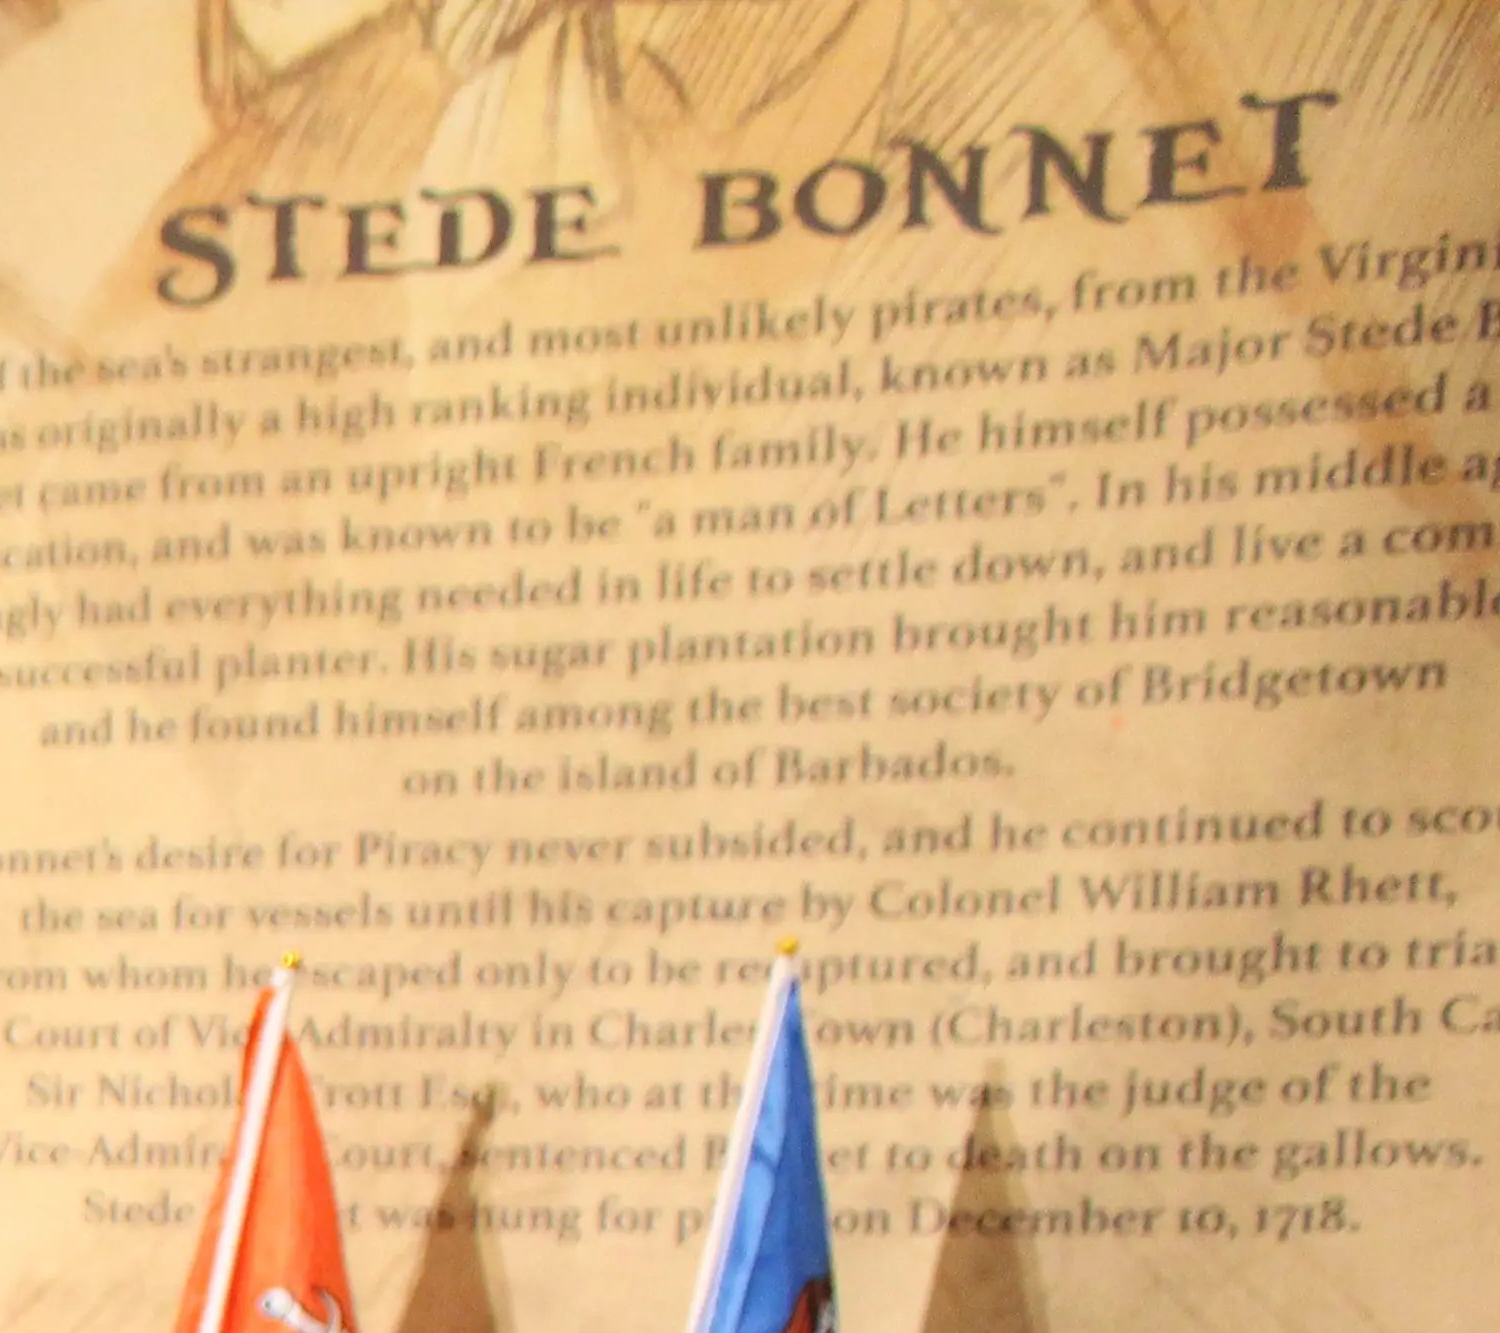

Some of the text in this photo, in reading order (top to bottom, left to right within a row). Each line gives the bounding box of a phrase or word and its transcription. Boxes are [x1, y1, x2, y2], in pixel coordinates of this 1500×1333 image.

[156, 91, 1341, 309] STEDE BONNET
[20, 350, 84, 391] the
[428, 319, 513, 364] and
[528, 319, 639, 358] most
[655, 293, 855, 348] unlikely
[871, 287, 1058, 344] pirates,
[1072, 270, 1197, 312] from
[1215, 250, 1299, 299] the
[35, 400, 245, 455] originally
[259, 409, 282, 437] a
[296, 390, 397, 443] high
[410, 383, 591, 428] ranking
[606, 357, 864, 414] individual,
[879, 355, 1048, 394] known
[1064, 349, 1117, 380] as
[1134, 326, 1292, 375] Major
[1304, 301, 1459, 356] Stede
[37, 478, 147, 516] came
[159, 462, 265, 503] from
[279, 467, 333, 497] an
[347, 447, 517, 504] upright
[533, 434, 696, 483] French
[896, 418, 962, 460] He
[979, 396, 1177, 452] himself
[1185, 369, 1449, 441] possessed
[1464, 378, 1492, 413] a
[151, 521, 231, 564] and
[245, 529, 327, 558] was
[340, 516, 493, 554] known
[508, 516, 553, 545] to
[566, 503, 621, 543] be
[692, 503, 795, 535] man
[808, 487, 864, 529] of
[1097, 471, 1147, 510] In
[1165, 462, 1239, 505] his
[1255, 442, 1447, 496] middle
[75, 586, 152, 628] had
[164, 578, 403, 630] everything
[417, 566, 582, 612] needed
[598, 568, 641, 605] in
[657, 559, 733, 601] life
[747, 567, 795, 597] to
[807, 548, 938, 592] settle
[952, 541, 1105, 585] down,
[1119, 526, 1215, 574] and
[1233, 523, 1324, 565] live
[1338, 529, 1367, 559] a
[214, 641, 388, 695] planter.
[403, 636, 477, 675] His
[489, 640, 612, 681] sugar
[628, 619, 875, 678] plantation
[893, 603, 1091, 658] brought
[1110, 599, 1207, 641] him
[39, 657, 1448, 748] and he found himself among the best society of Bridgetown
[401, 739, 1015, 797] on the island of Barbados.
[134, 835, 264, 872] desire
[277, 831, 340, 870] for
[355, 831, 493, 876] Piracy
[505, 836, 632, 865] never
[646, 815, 868, 862] subsided,
[882, 813, 973, 856] and
[990, 812, 1048, 853] he
[1061, 798, 1325, 848] continued
[1342, 807, 1393, 839] to
[20, 863, 1458, 936] the sea for vessels until his capture by Colonel William Rhett,
[82, 954, 208, 991] whom
[474, 949, 575, 1001] only
[586, 956, 633, 988] to
[647, 947, 701, 986] be
[1006, 938, 1097, 980] and
[1115, 930, 1322, 985] brought
[1339, 940, 1390, 971] to
[2, 1018, 120, 1052] Court
[132, 1014, 179, 1050] of
[299, 1013, 516, 1061] Admiralty
[532, 1011, 574, 1050] in
[929, 1003, 1255, 1048] (Charleston),
[1270, 995, 1422, 1039] South
[26, 1074, 82, 1109] Sir
[535, 1071, 632, 1111] who
[643, 1082, 684, 1111] at
[1030, 1068, 1107, 1110] the
[1123, 1066, 1267, 1117] judge
[1280, 1062, 1339, 1104] of
[1349, 1061, 1432, 1103] the
[456, 1127, 1483, 1180] sentenced to death on the gallows.
[83, 1190, 195, 1227] Stede
[596, 1195, 661, 1234] for
[909, 1191, 1166, 1236] December
[1178, 1204, 1239, 1239] 10,
[1255, 1196, 1360, 1242] 1718.
